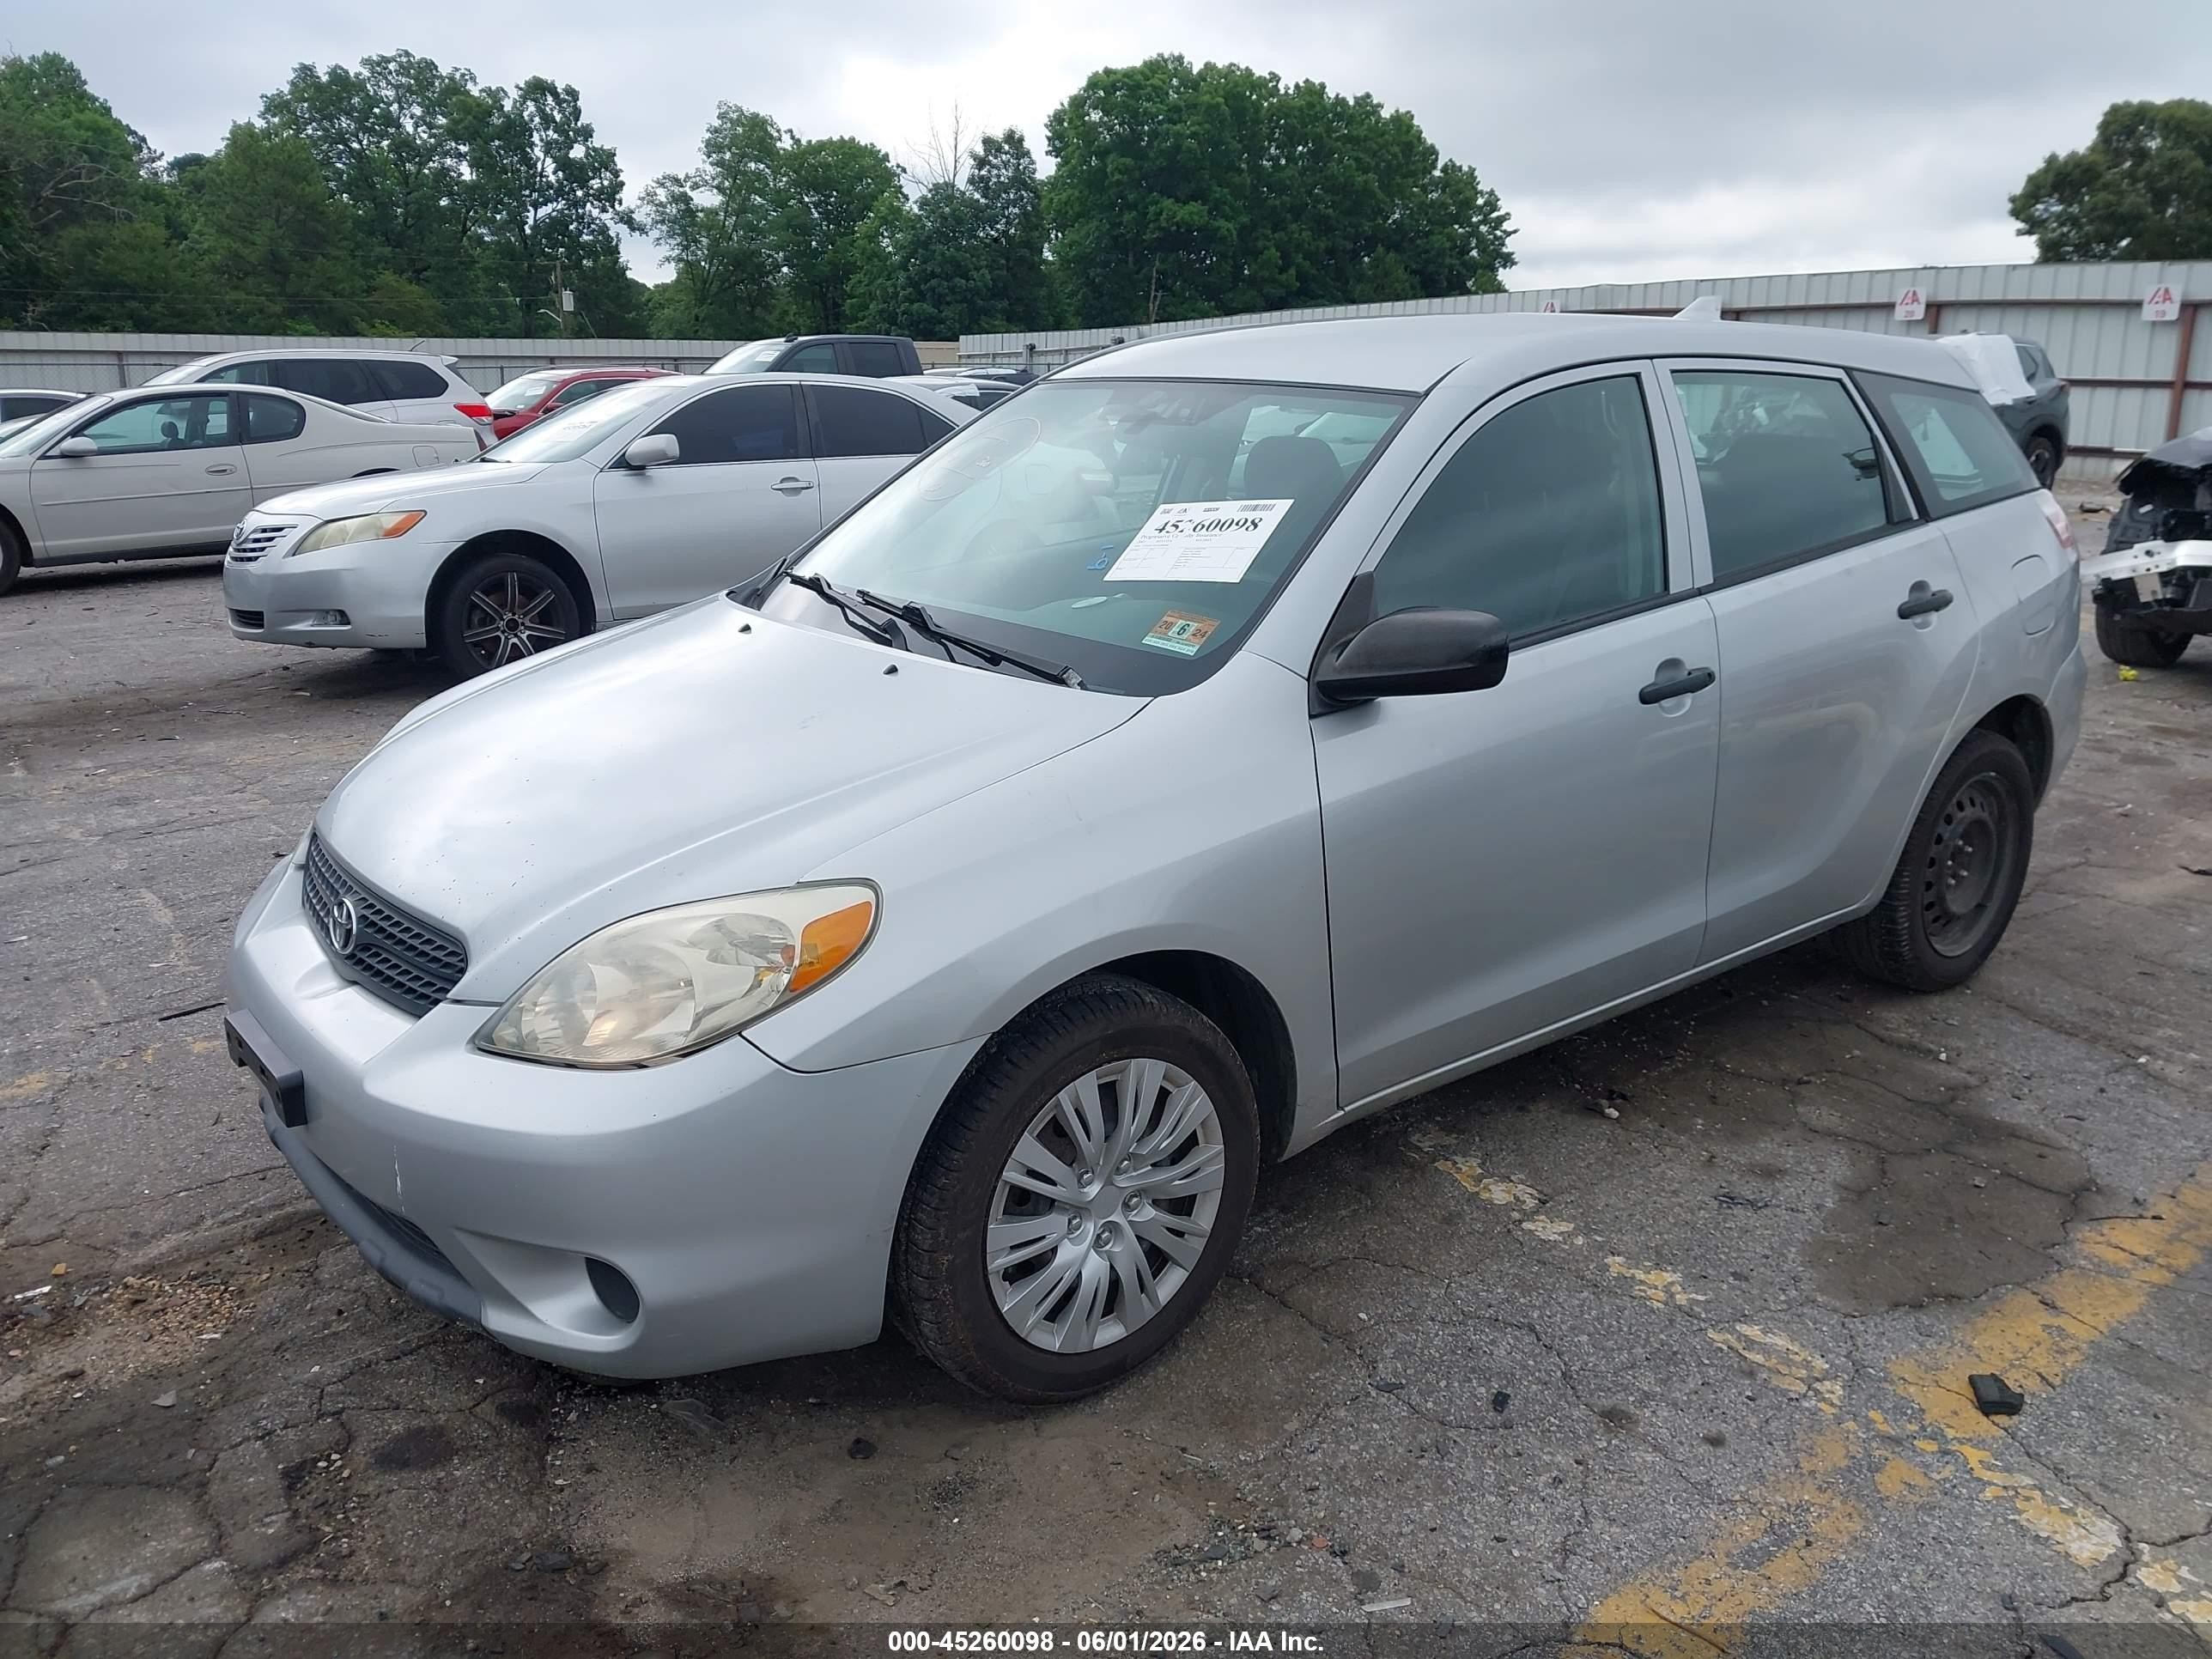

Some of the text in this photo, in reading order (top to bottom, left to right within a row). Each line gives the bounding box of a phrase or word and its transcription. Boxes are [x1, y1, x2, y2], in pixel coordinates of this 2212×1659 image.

[1158, 620, 1209, 639] 20 6 24
